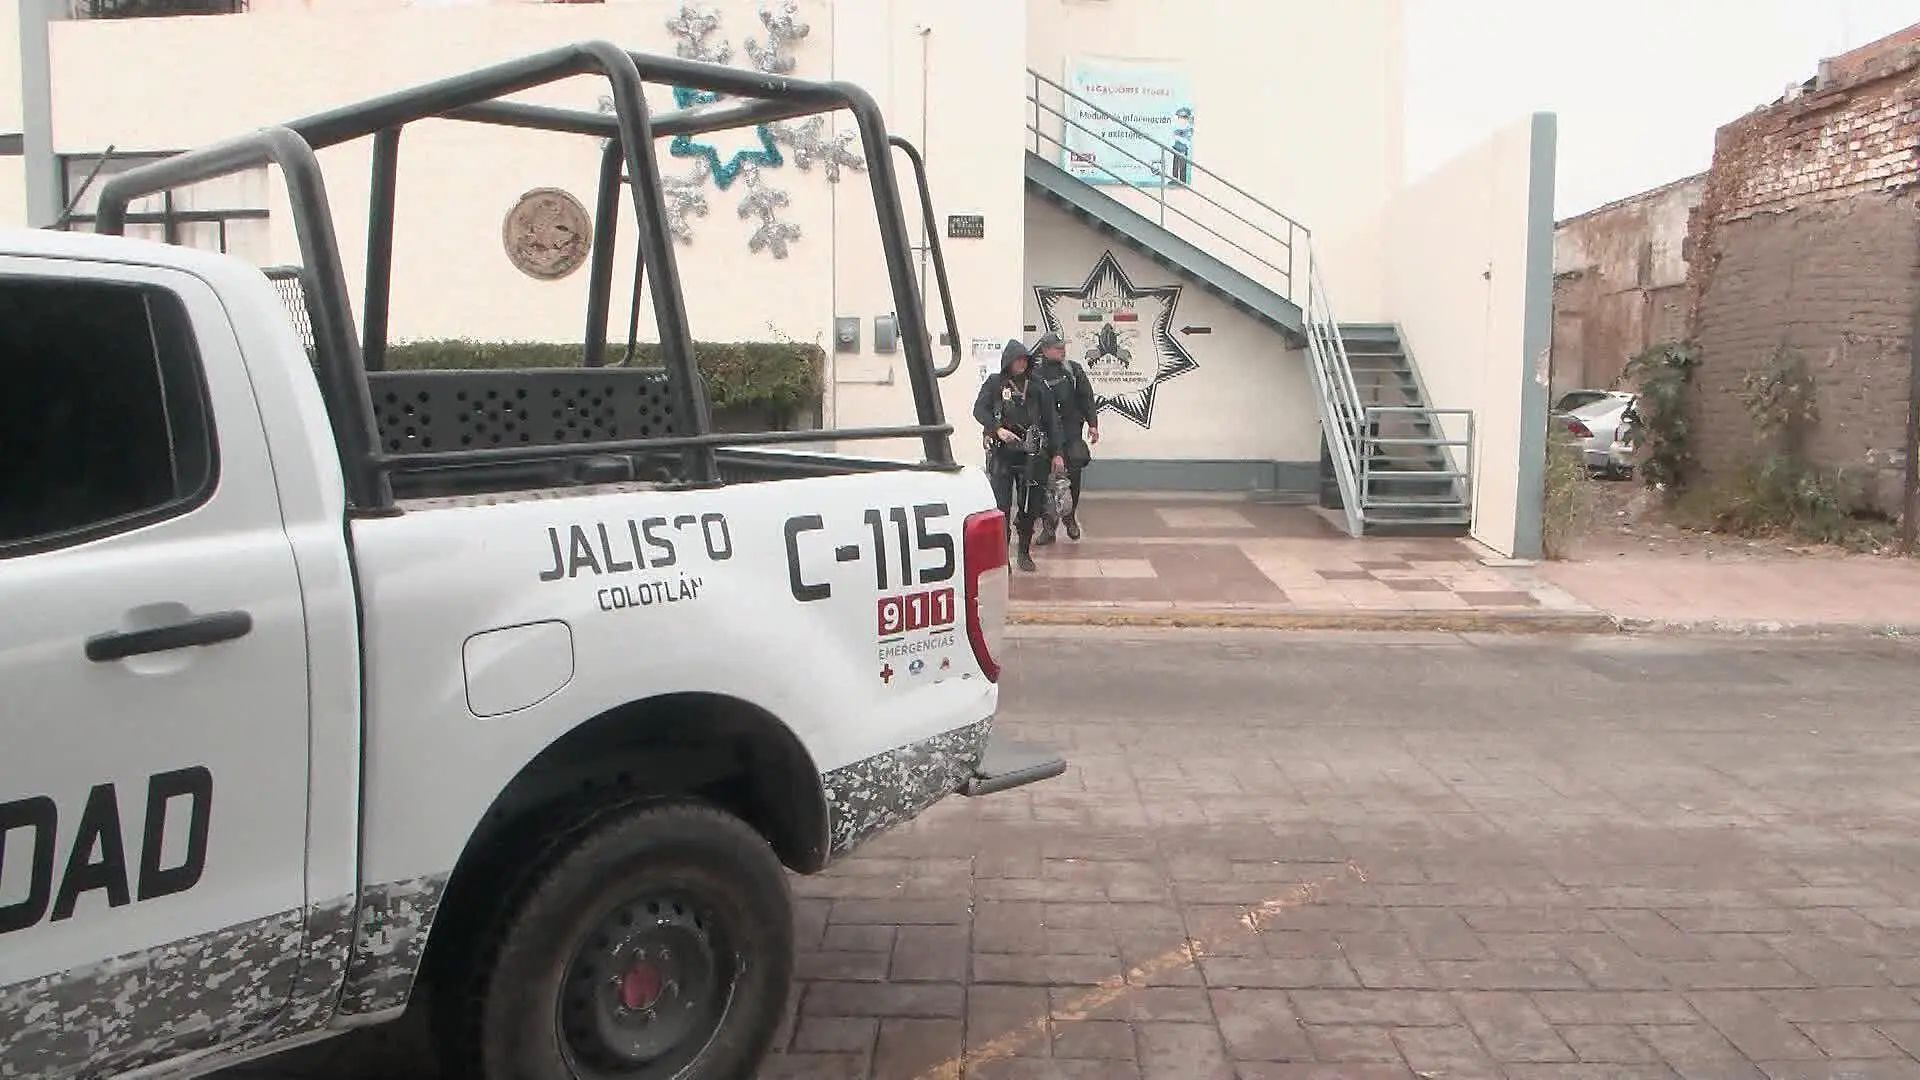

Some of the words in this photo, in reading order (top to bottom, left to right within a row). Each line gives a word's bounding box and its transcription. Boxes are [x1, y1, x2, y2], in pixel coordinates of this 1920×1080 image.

[539, 512, 733, 581] JALISO
[784, 503, 956, 602] C-115
[880, 590, 951, 632] 911
[879, 636, 954, 661] EMERGENCIAS
